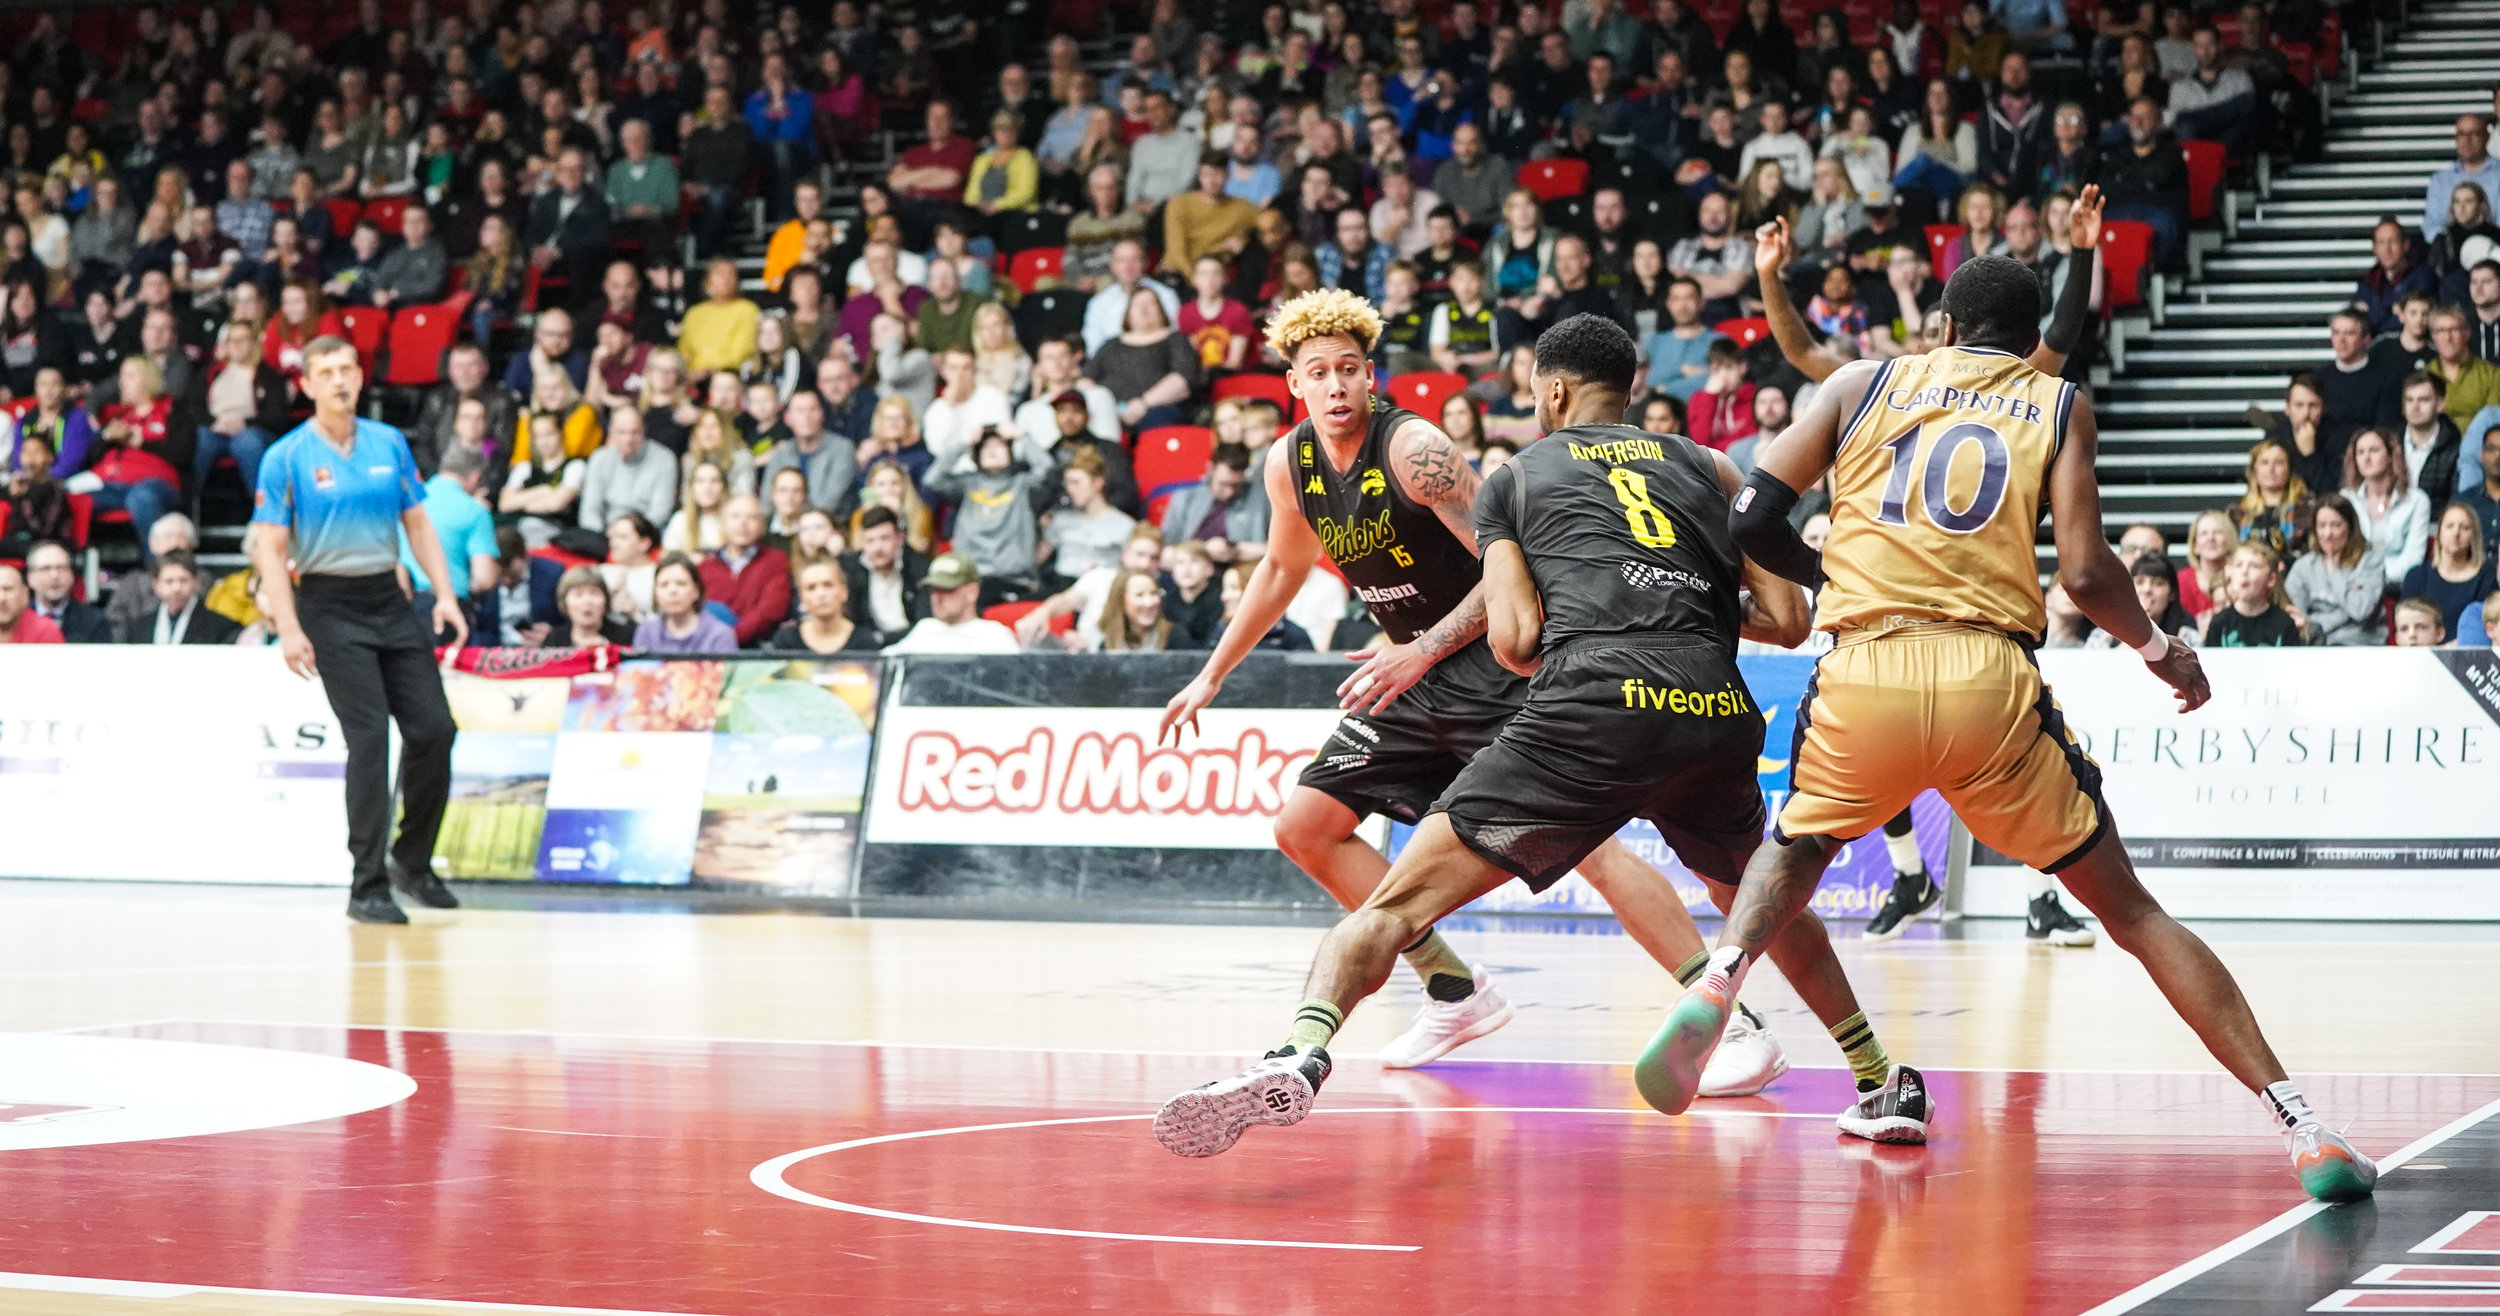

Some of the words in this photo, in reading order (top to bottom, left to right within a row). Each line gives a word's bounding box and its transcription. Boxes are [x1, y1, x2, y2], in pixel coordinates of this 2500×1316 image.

[1886, 386, 2042, 425] CARPENTER
[1872, 419, 2011, 535] 10
[1607, 468, 1677, 548] 8
[1318, 509, 1395, 566] Riders
[1388, 545, 1415, 568] 15
[1651, 566, 1712, 592] Preier
[1371, 595, 1428, 613] OMES
[2240, 687, 2299, 706] TH
[898, 726, 1055, 814] Red
[2196, 785, 2335, 805] HOTEL
[2172, 846, 2244, 861] CONFERENCE
[2245, 847, 2255, 861] &
[2257, 846, 2299, 861] EVENTS
[2316, 847, 2397, 861] CELEBRATIONS
[2415, 847, 2460, 861] LEISURE
